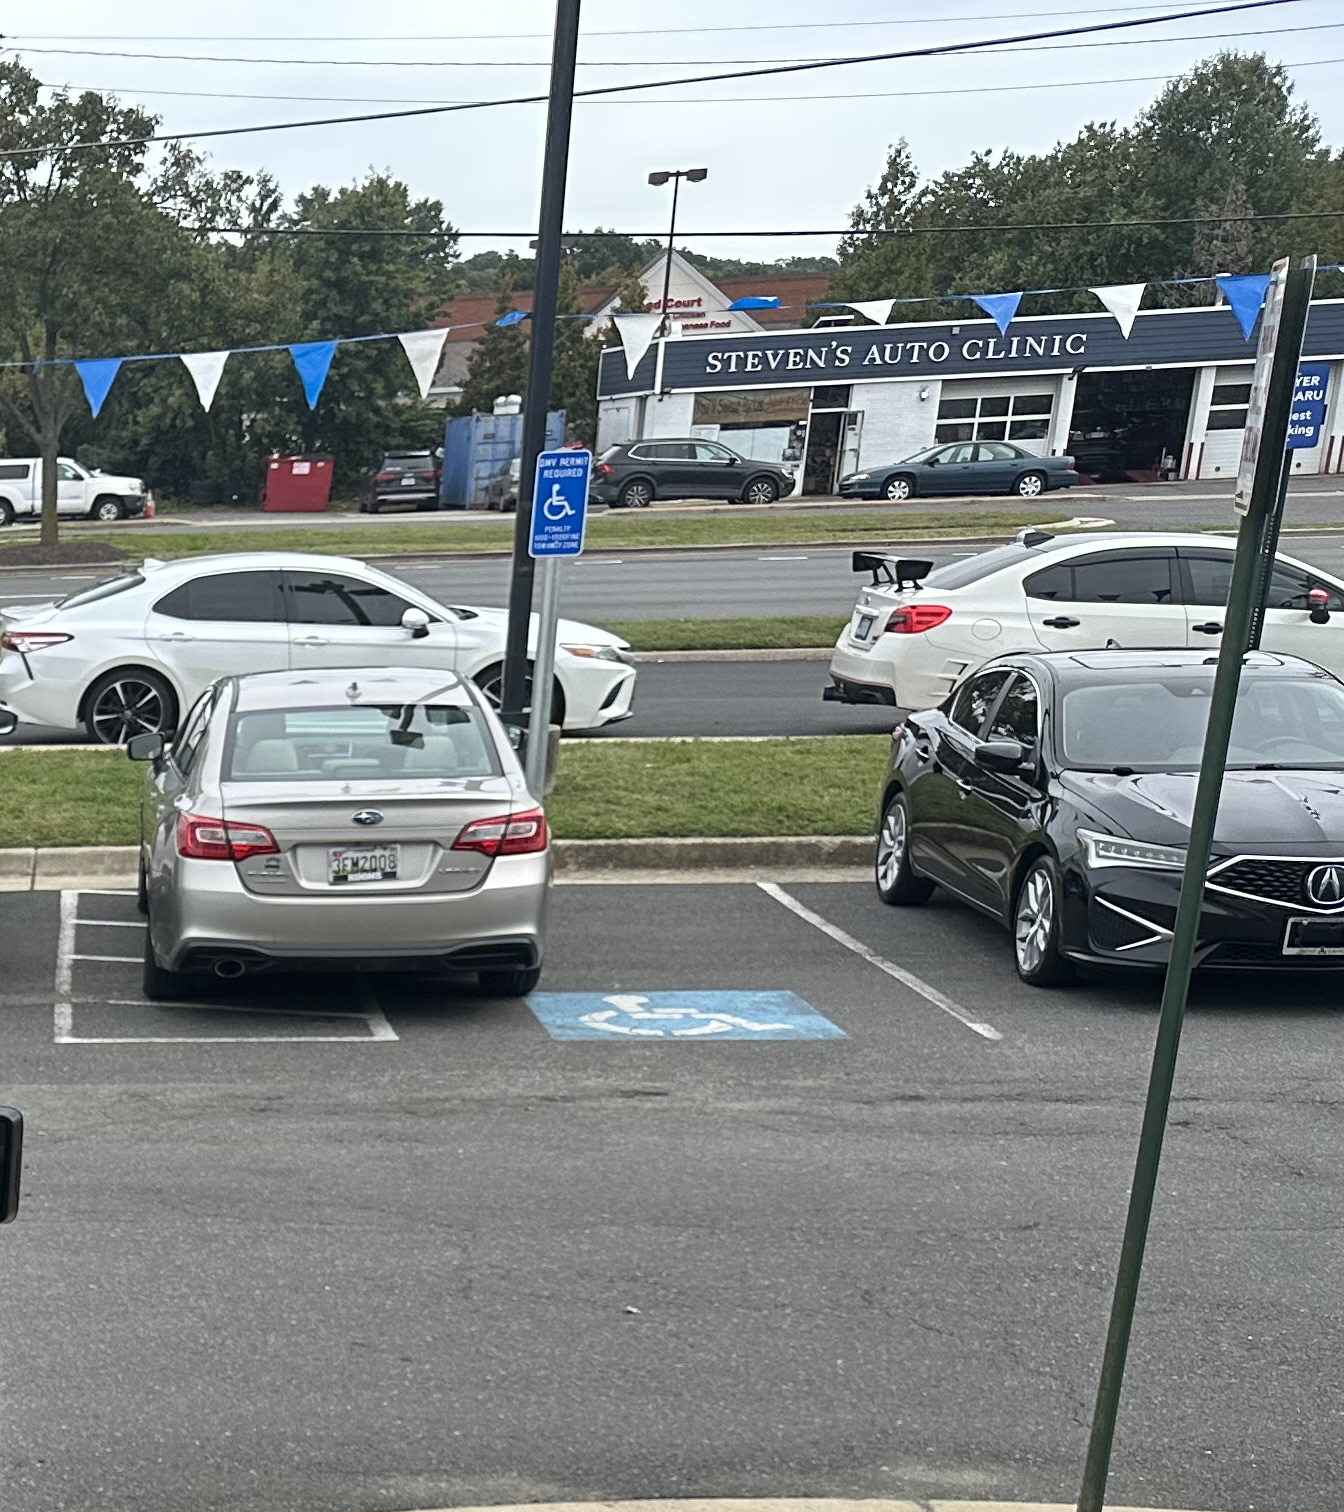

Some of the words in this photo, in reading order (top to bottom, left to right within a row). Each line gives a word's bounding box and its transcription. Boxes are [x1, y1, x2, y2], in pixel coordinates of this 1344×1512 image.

[666, 297, 702, 308] Court
[710, 320, 731, 328] Food
[706, 340, 853, 374] STEVEN'S
[862, 341, 950, 366] AUTO
[962, 333, 1088, 360] CLINIC
[559, 457, 588, 466] PERMIT
[543, 468, 583, 478] REQUIRED
